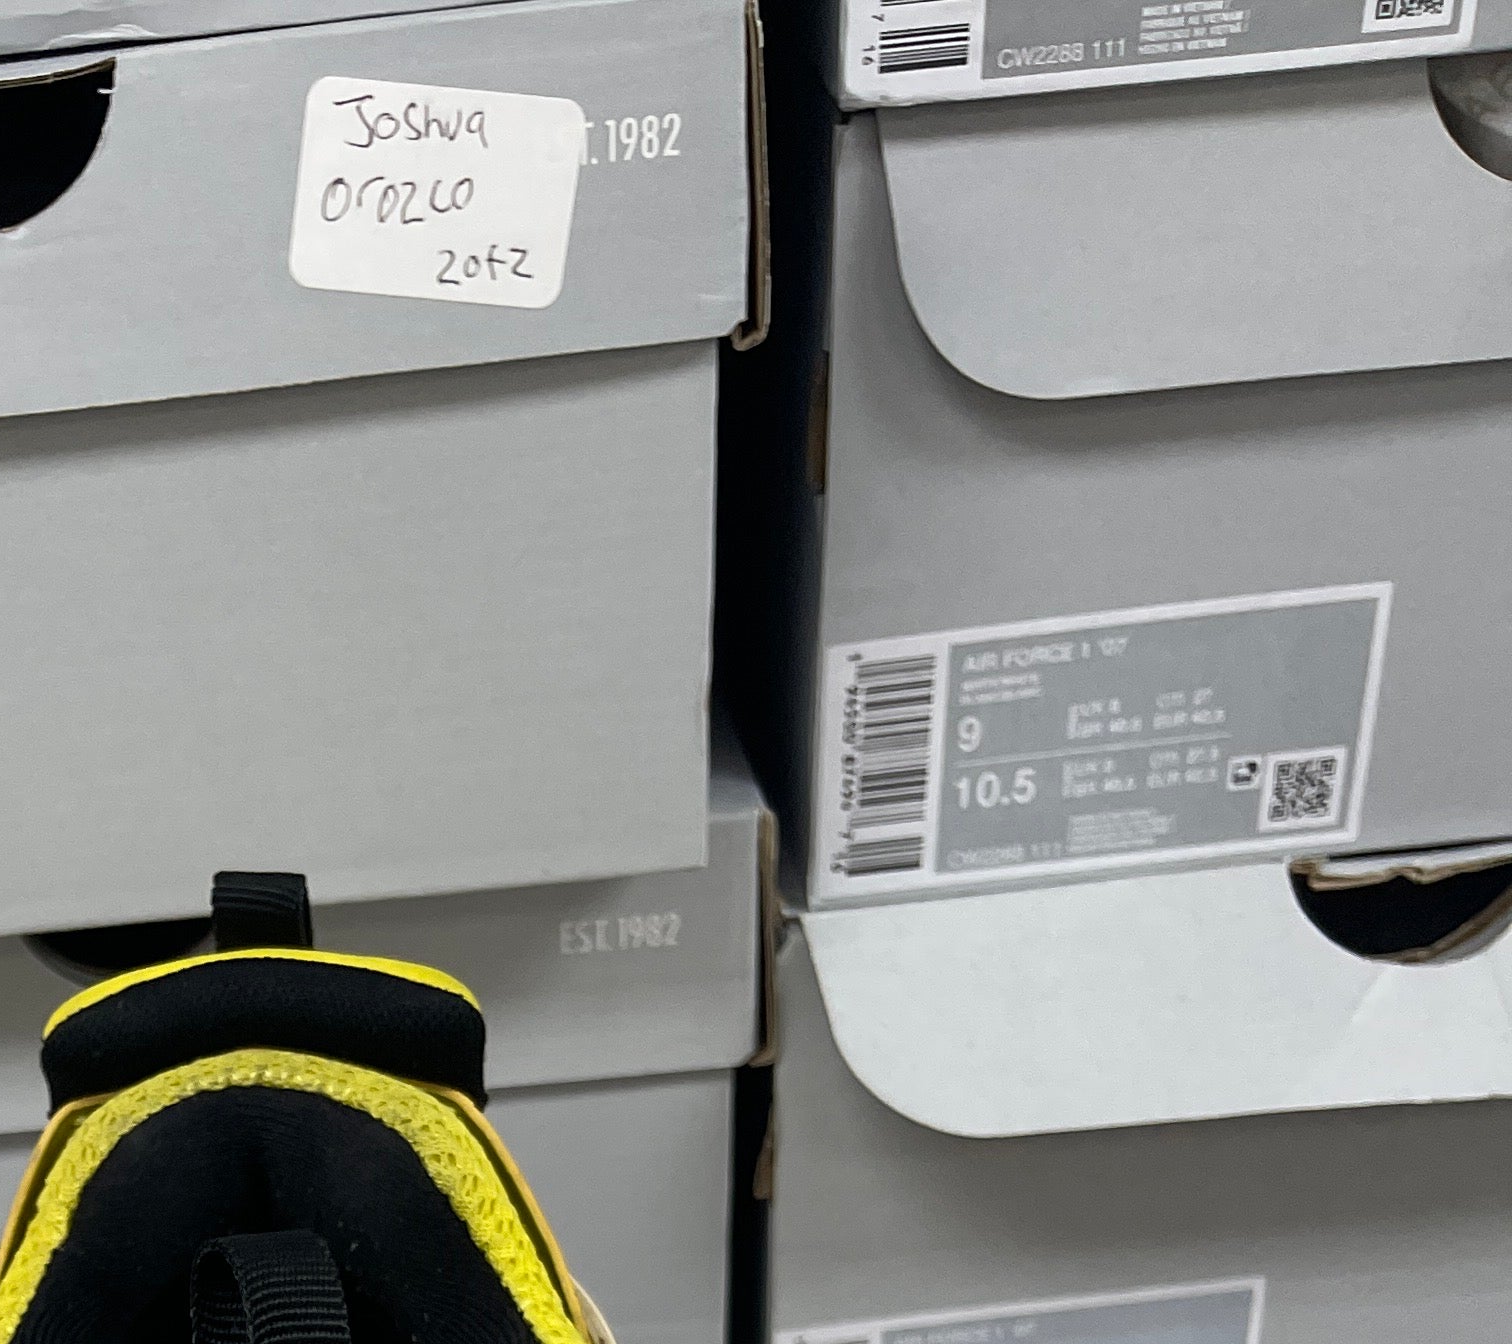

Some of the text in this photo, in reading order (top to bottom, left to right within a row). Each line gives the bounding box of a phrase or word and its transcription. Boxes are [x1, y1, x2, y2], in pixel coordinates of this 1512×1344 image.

[1090, 38, 1126, 60] 111
[957, 714, 983, 753] 9
[954, 766, 1037, 809] 10.5
